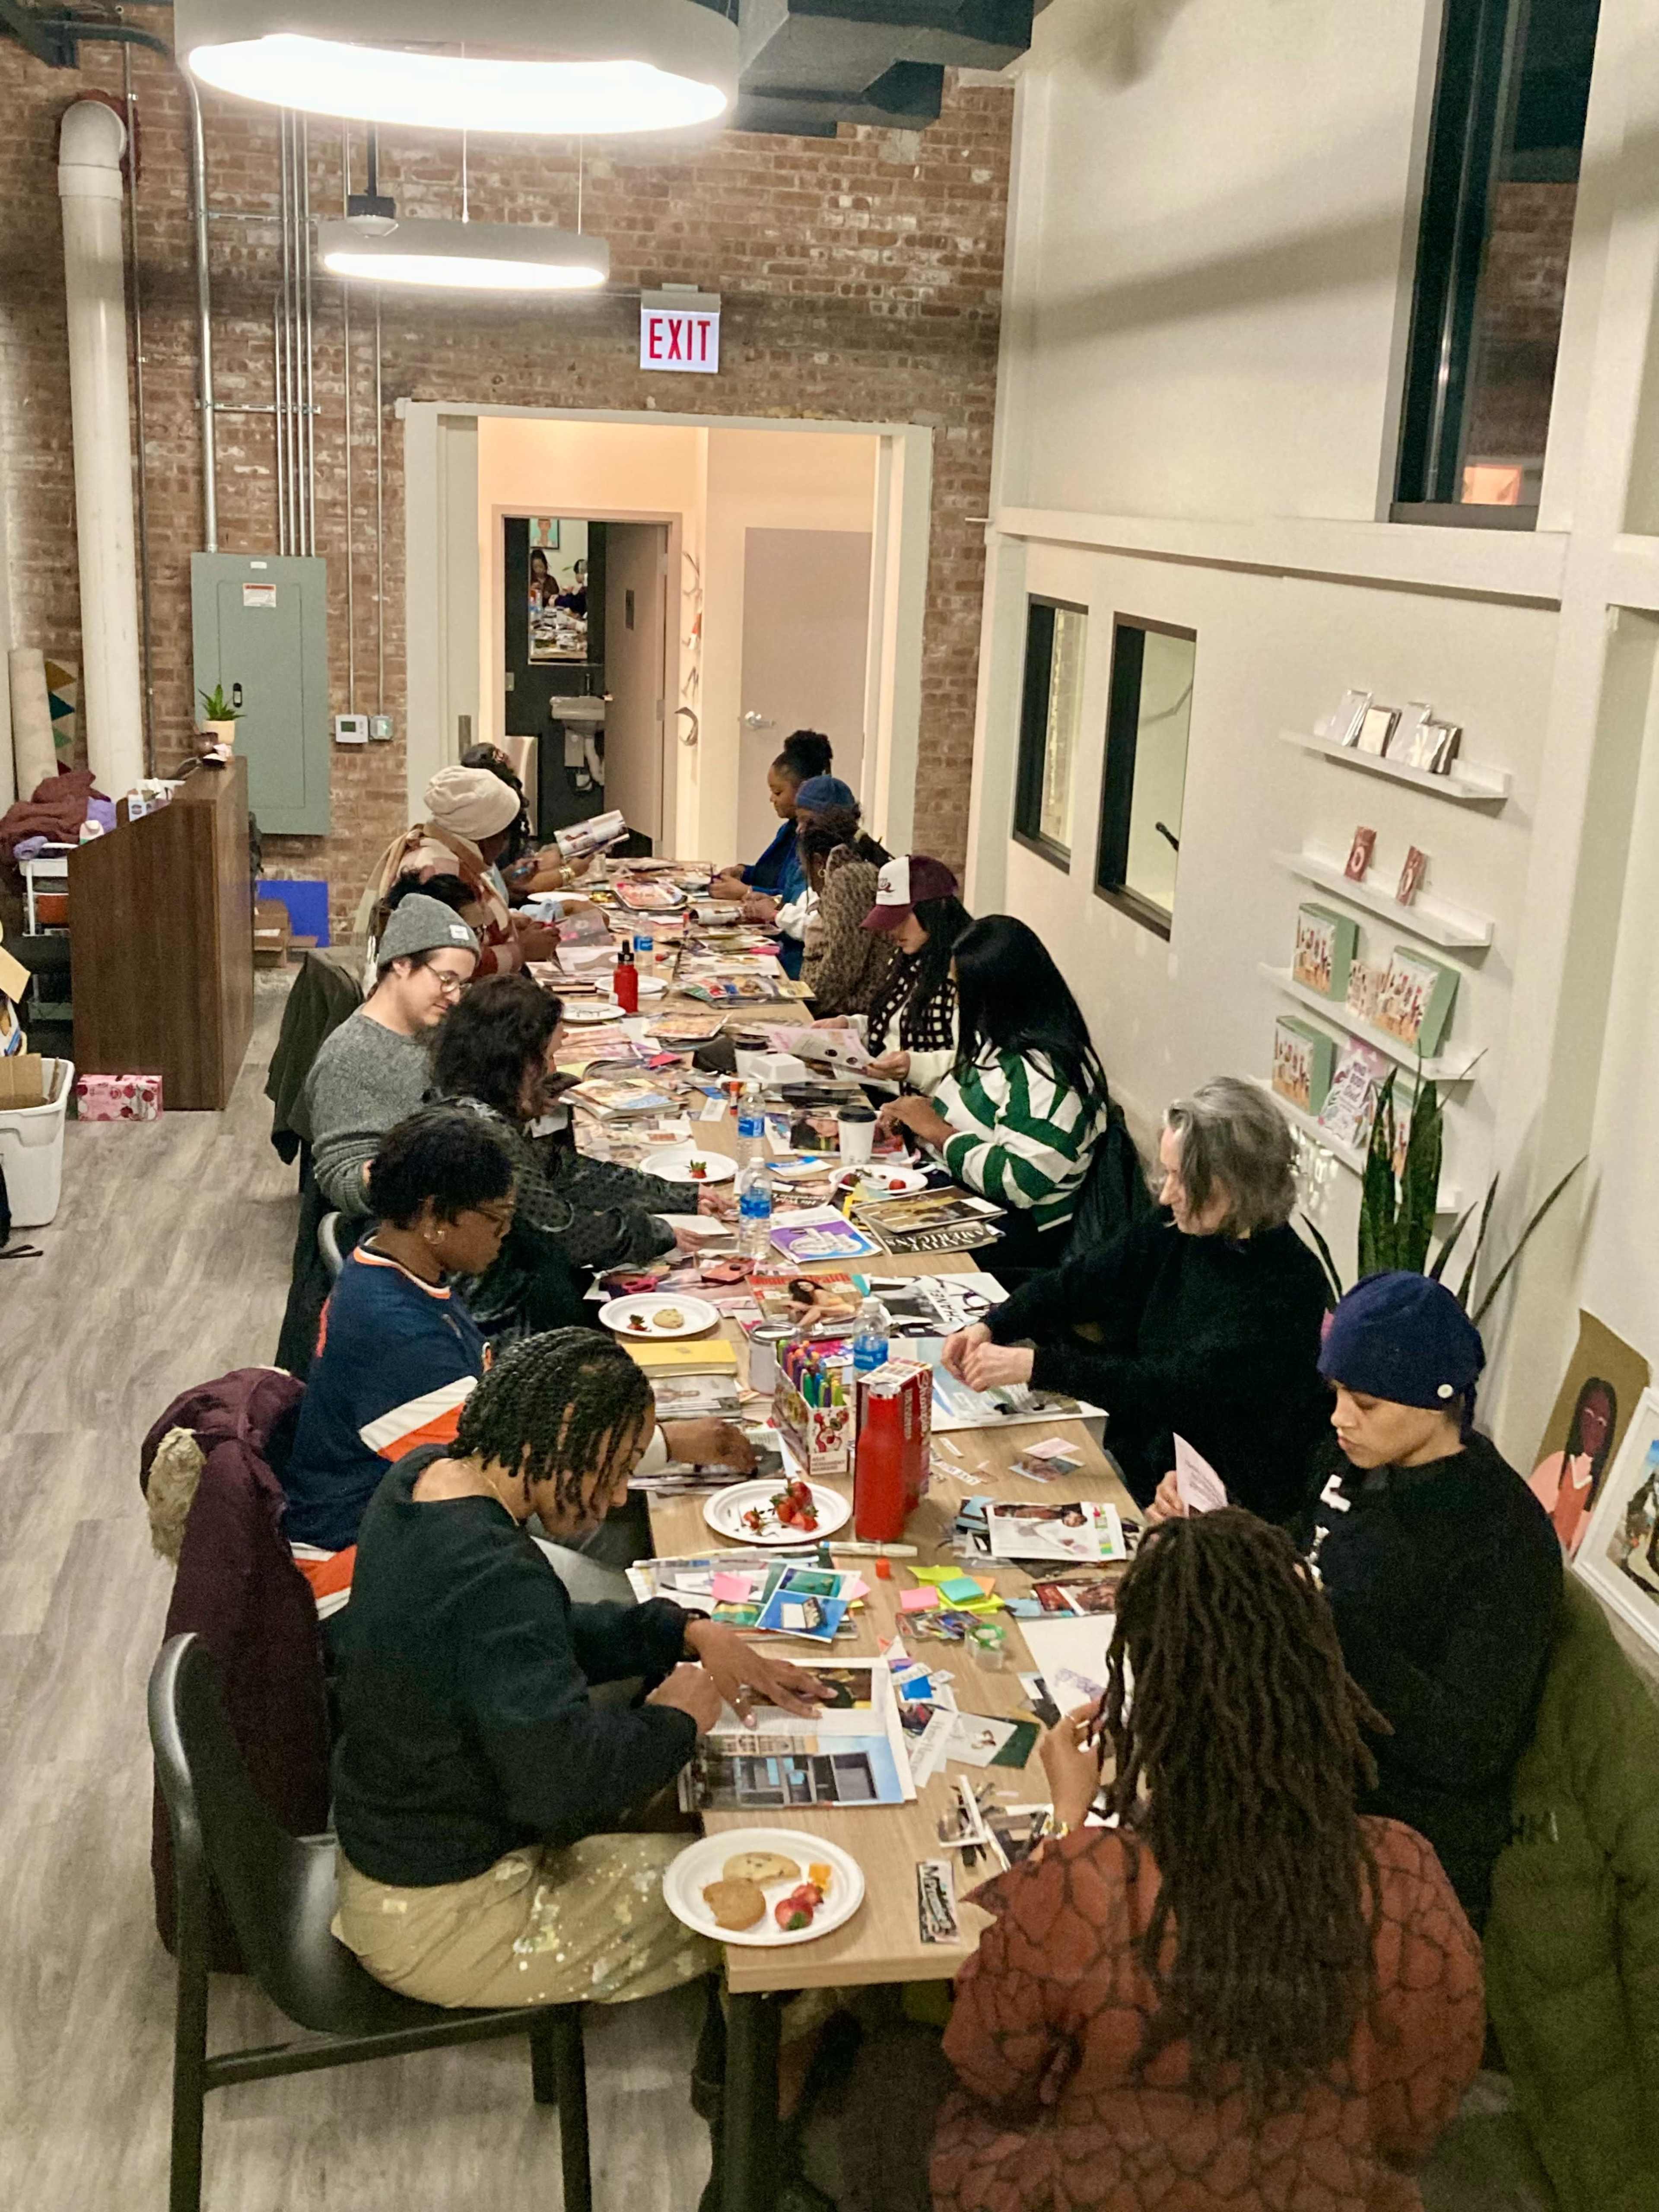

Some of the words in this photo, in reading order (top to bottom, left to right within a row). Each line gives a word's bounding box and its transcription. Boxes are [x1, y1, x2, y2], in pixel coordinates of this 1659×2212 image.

[650, 318, 710, 361] EXIT
[886, 1230, 984, 1246] AMERICANS
[911, 1238, 974, 1252] NATIVE
